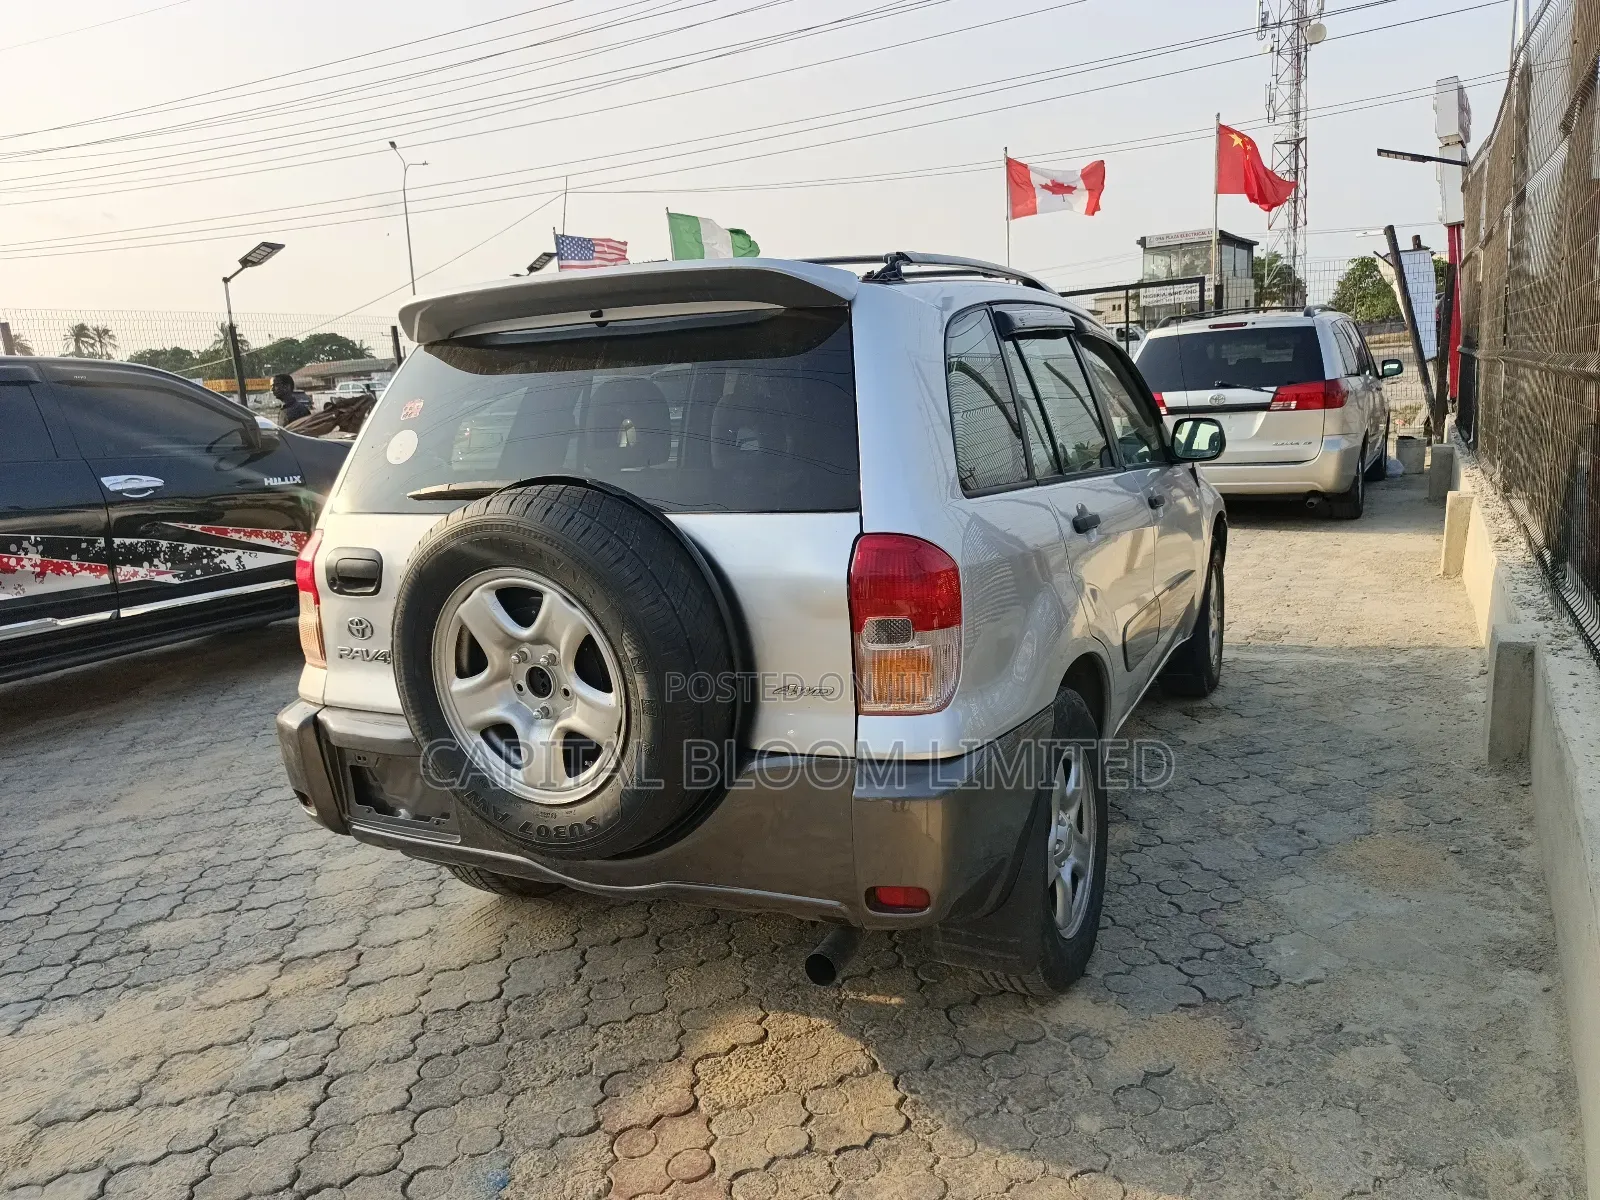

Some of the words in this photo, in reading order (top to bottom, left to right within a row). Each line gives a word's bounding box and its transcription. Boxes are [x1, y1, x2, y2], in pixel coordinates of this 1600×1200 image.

[263, 474, 302, 486] HILUX
[337, 645, 392, 665] RAV4
[772, 684, 834, 697] 4WD
